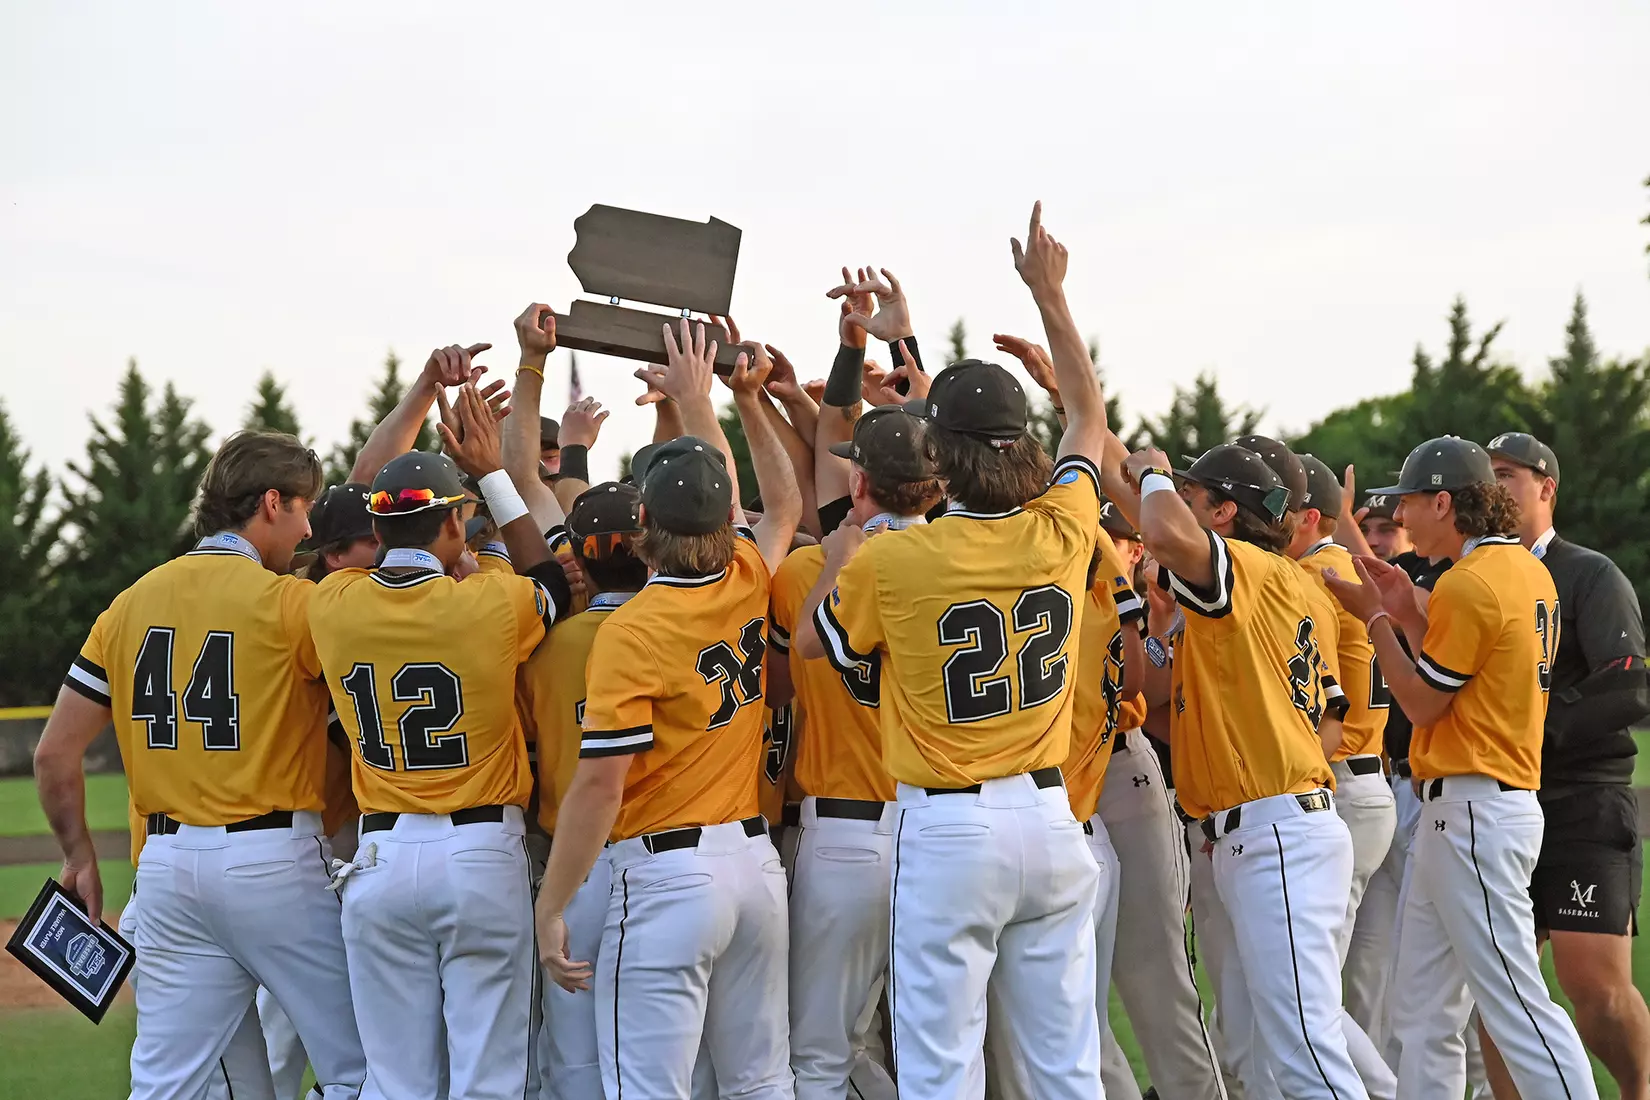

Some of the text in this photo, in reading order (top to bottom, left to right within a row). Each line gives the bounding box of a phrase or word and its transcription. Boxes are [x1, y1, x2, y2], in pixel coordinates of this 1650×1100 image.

[937, 583, 1068, 724] 22
[132, 626, 240, 751] 44
[340, 662, 469, 771] 12
[1570, 879, 1597, 908] M
[39, 908, 67, 949] VALUABLE PLAYER
[1558, 907, 1600, 918] BASEBALL
[55, 926, 66, 942] MOST
[73, 938, 97, 971] BASEBALL
